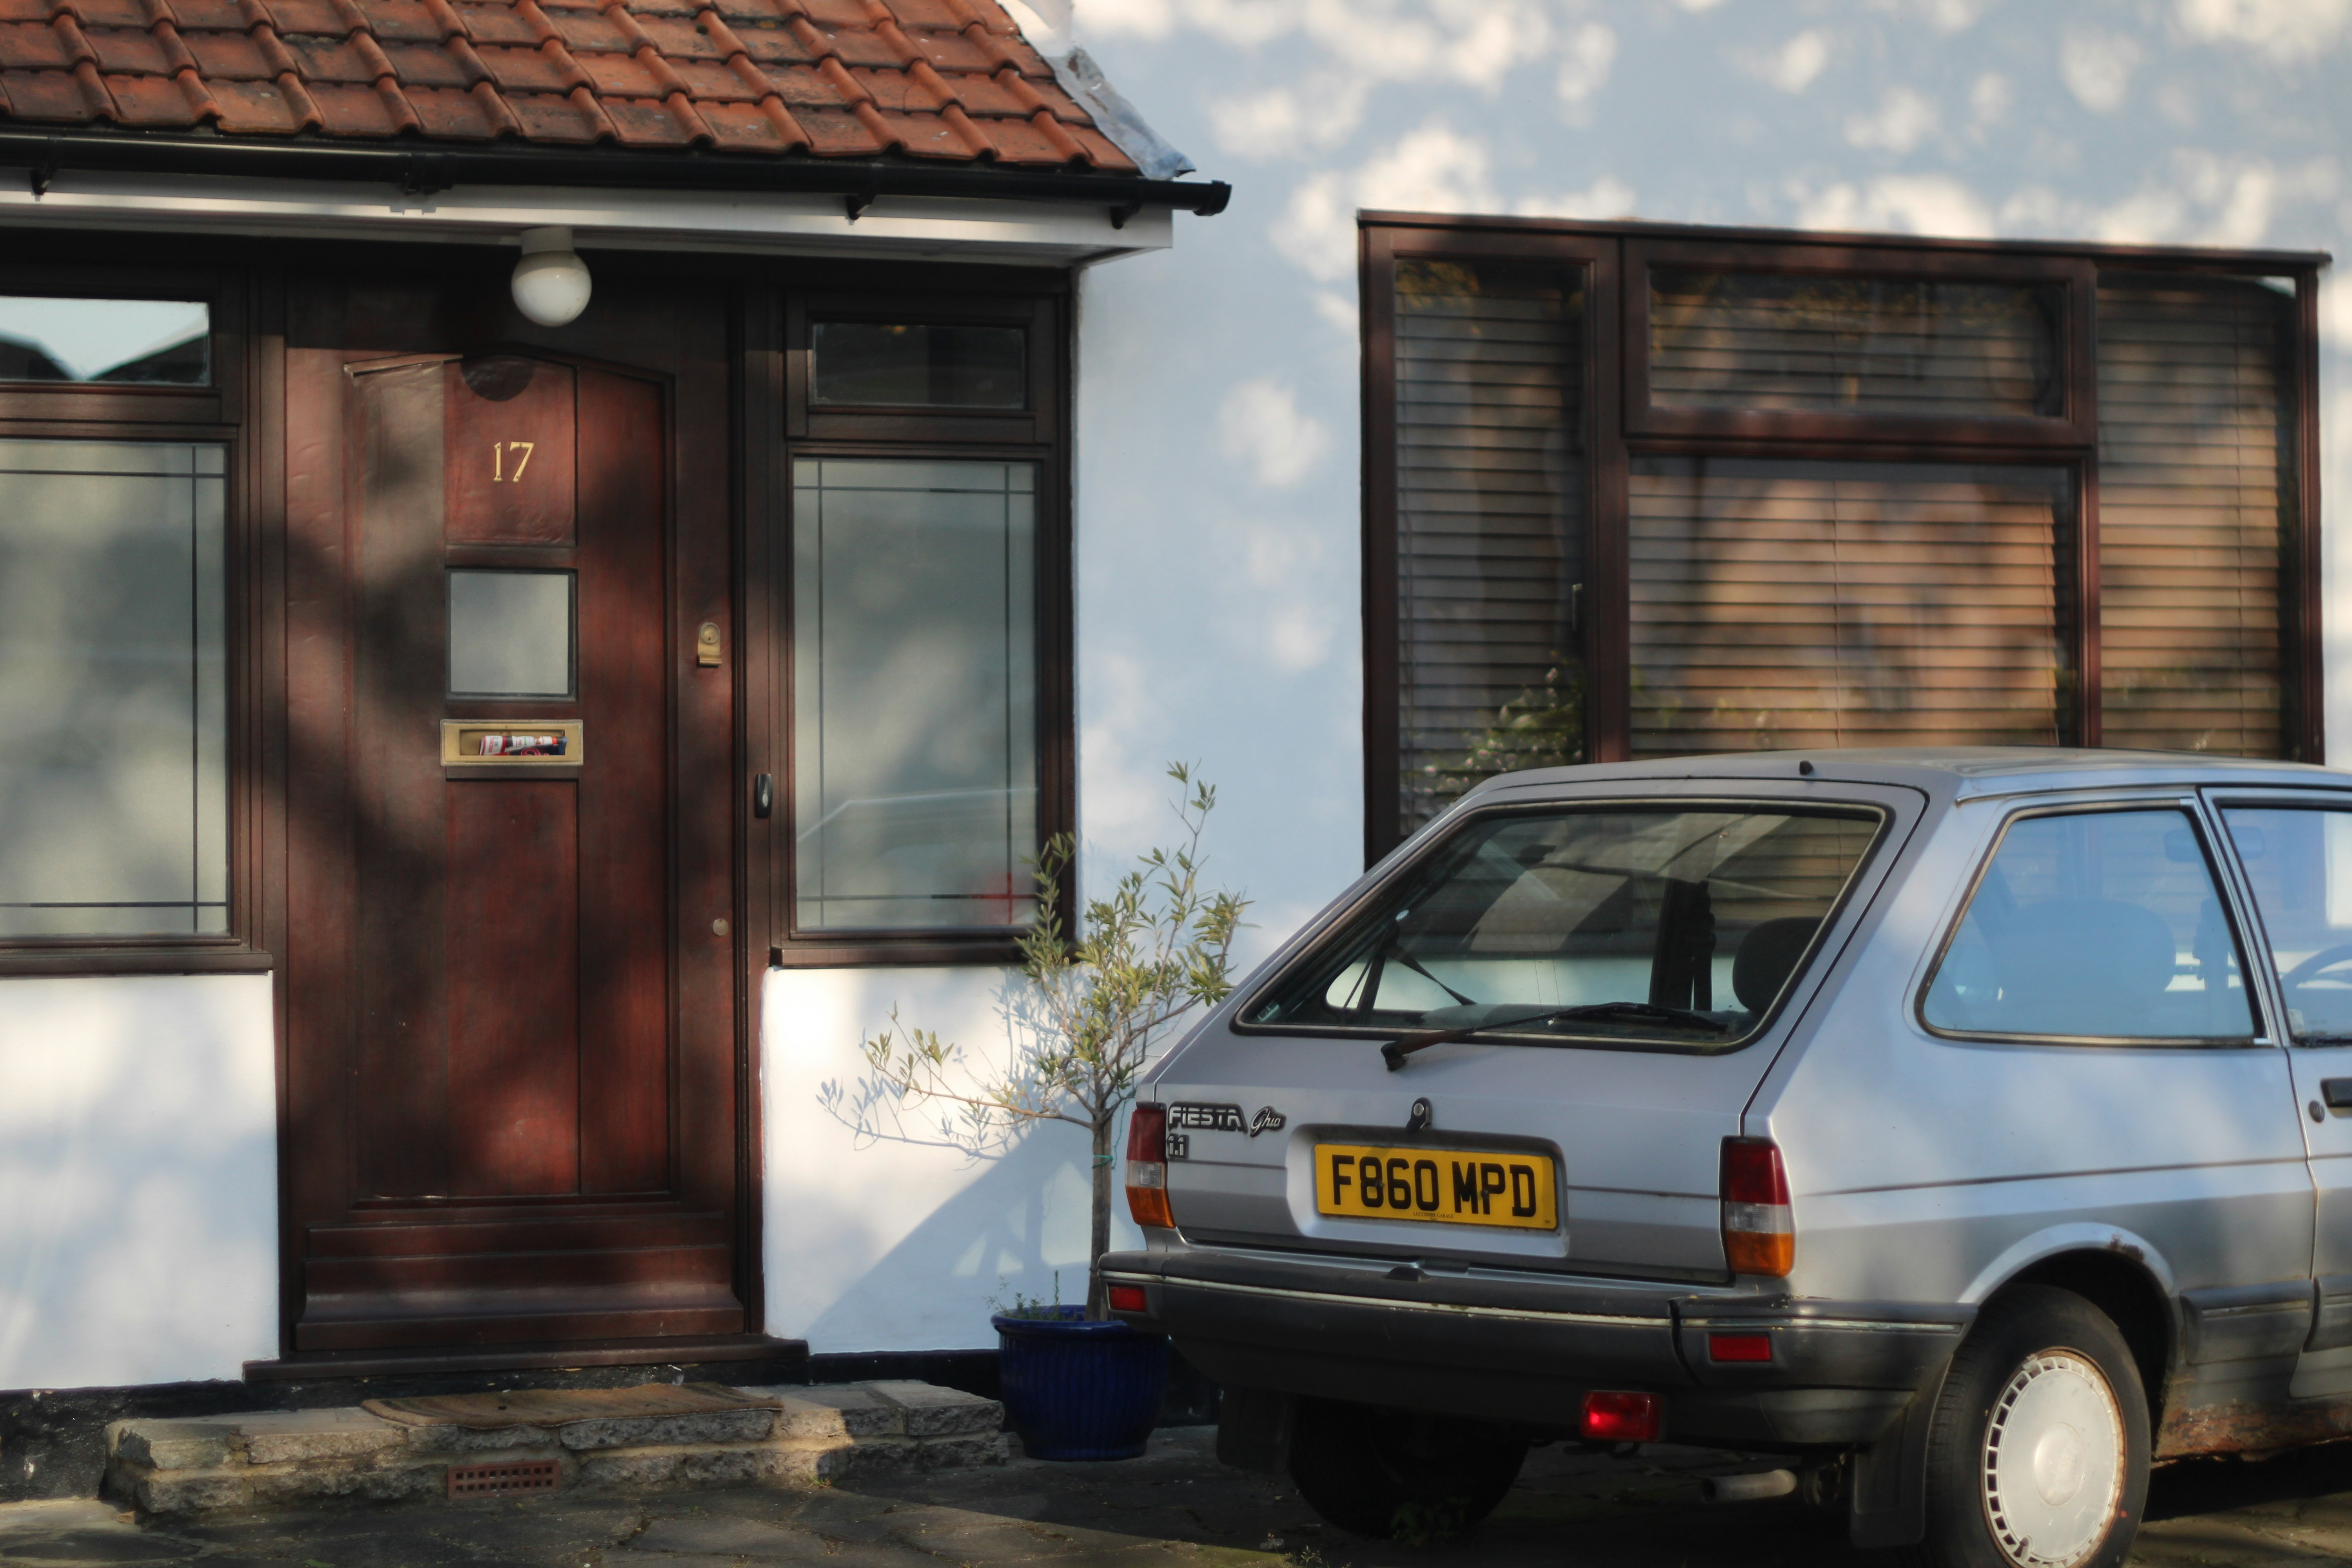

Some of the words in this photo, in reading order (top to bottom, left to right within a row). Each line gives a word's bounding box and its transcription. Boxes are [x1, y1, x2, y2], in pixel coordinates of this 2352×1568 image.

[494, 441, 534, 483] 17
[1169, 1106, 1243, 1127] FIESTA
[1250, 1106, 1283, 1134] Ghia
[1168, 1136, 1184, 1156] 1.1
[1332, 1154, 1440, 1211] F860
[1452, 1161, 1537, 1218] MPD
